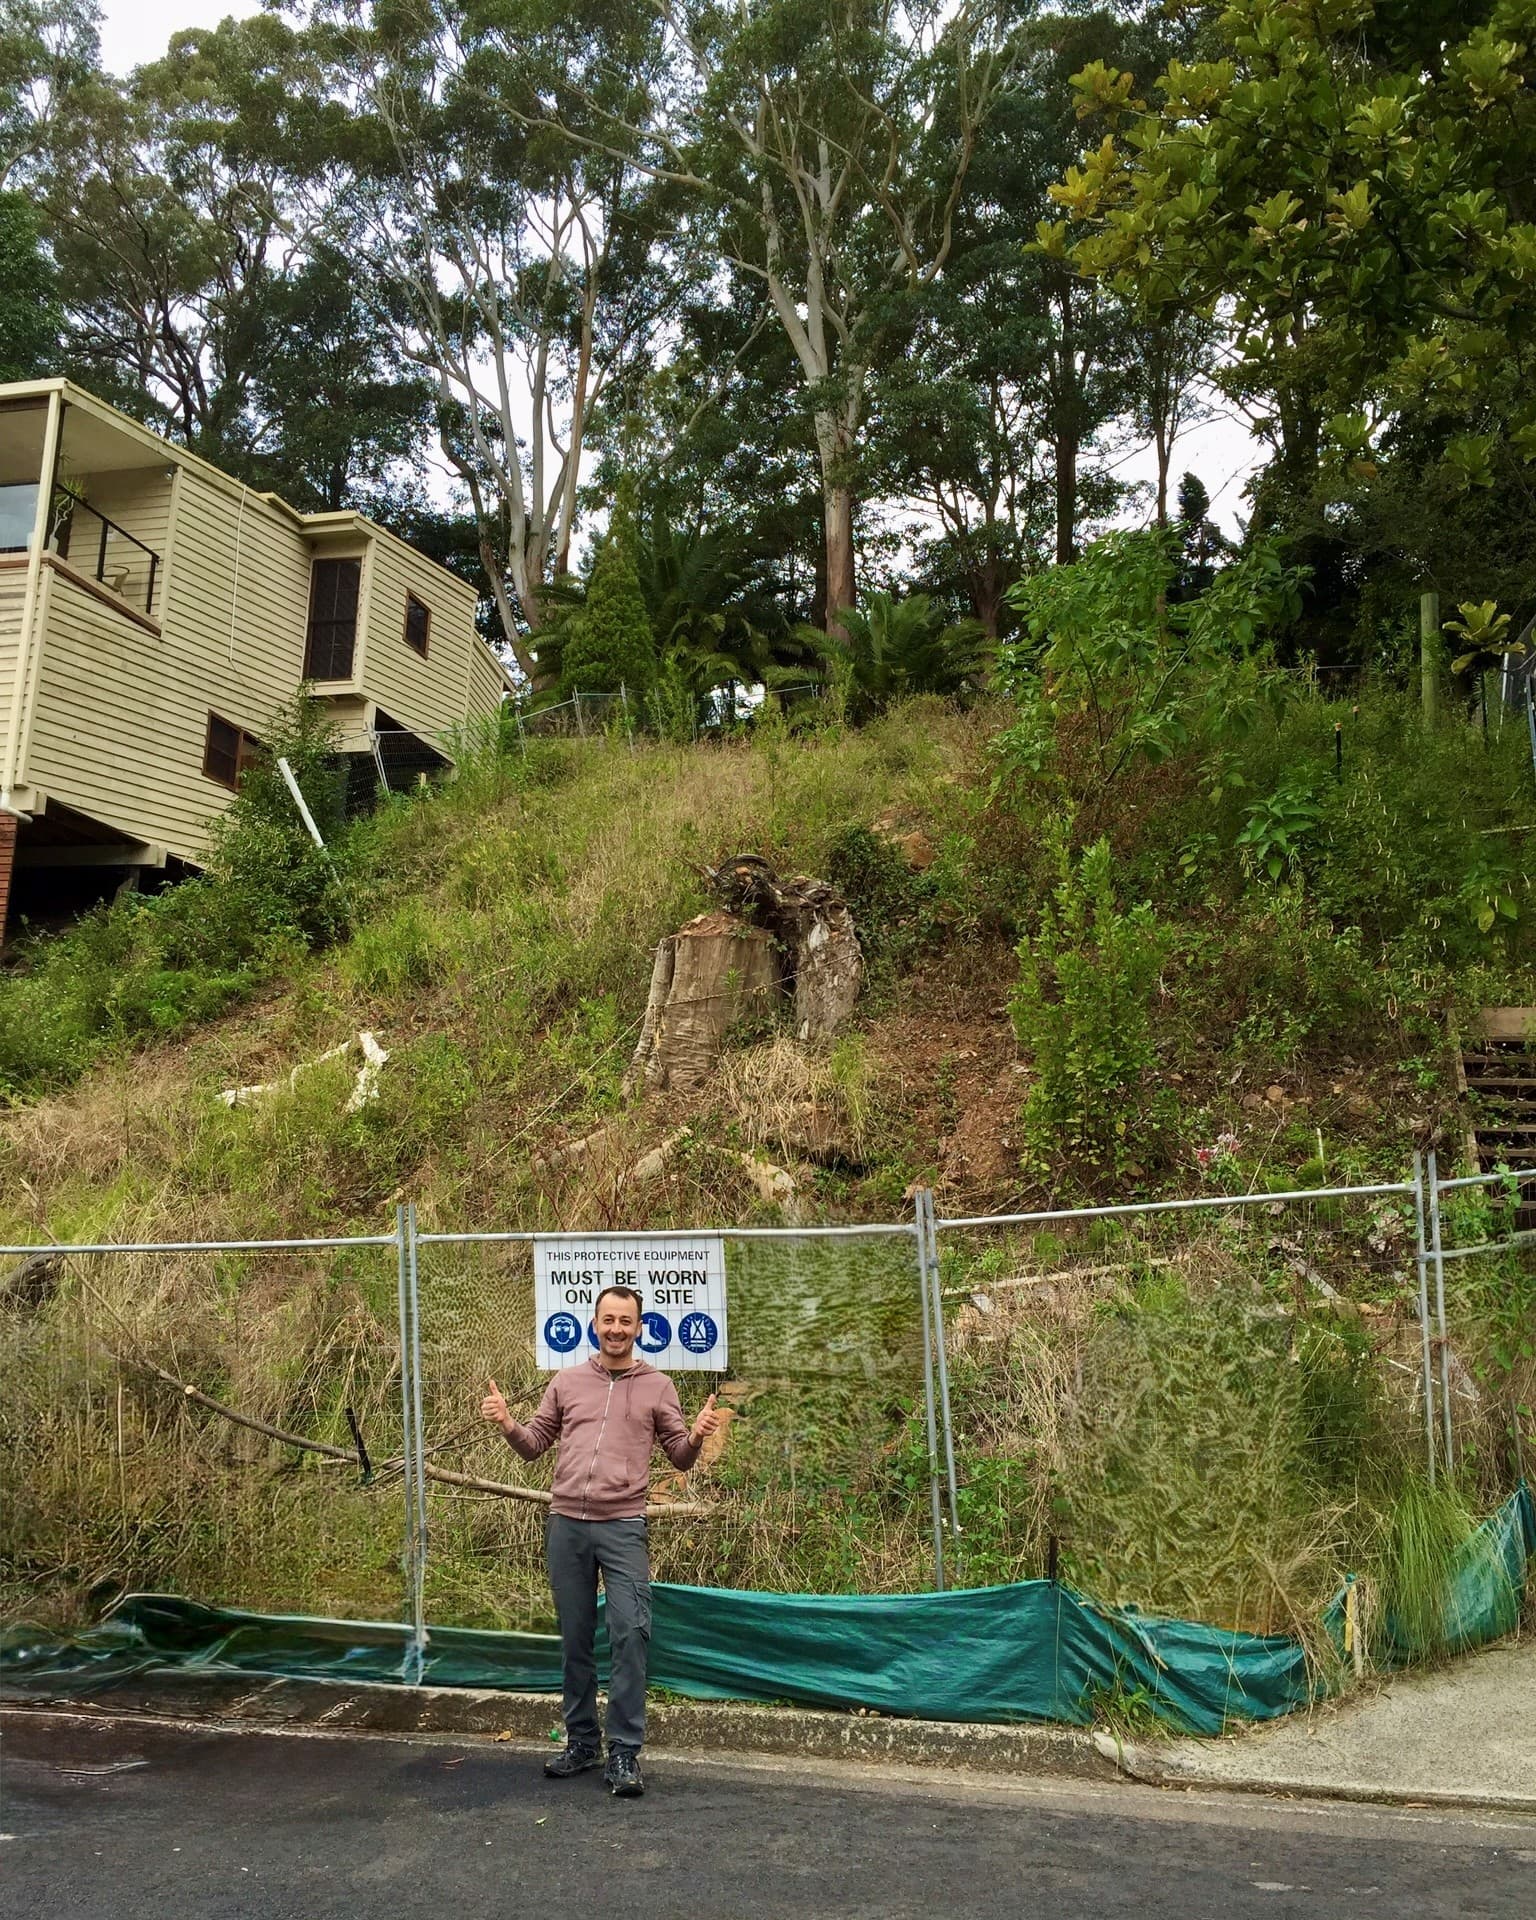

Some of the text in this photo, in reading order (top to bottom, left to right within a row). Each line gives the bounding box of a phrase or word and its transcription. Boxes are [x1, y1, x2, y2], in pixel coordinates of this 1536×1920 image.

[546, 1251, 710, 1261] THIS PROTECTIVE EQUIPMENT
[551, 1270, 707, 1285] MUST BE WORN
[565, 1289, 592, 1304] ON
[655, 1289, 694, 1304] SITE
